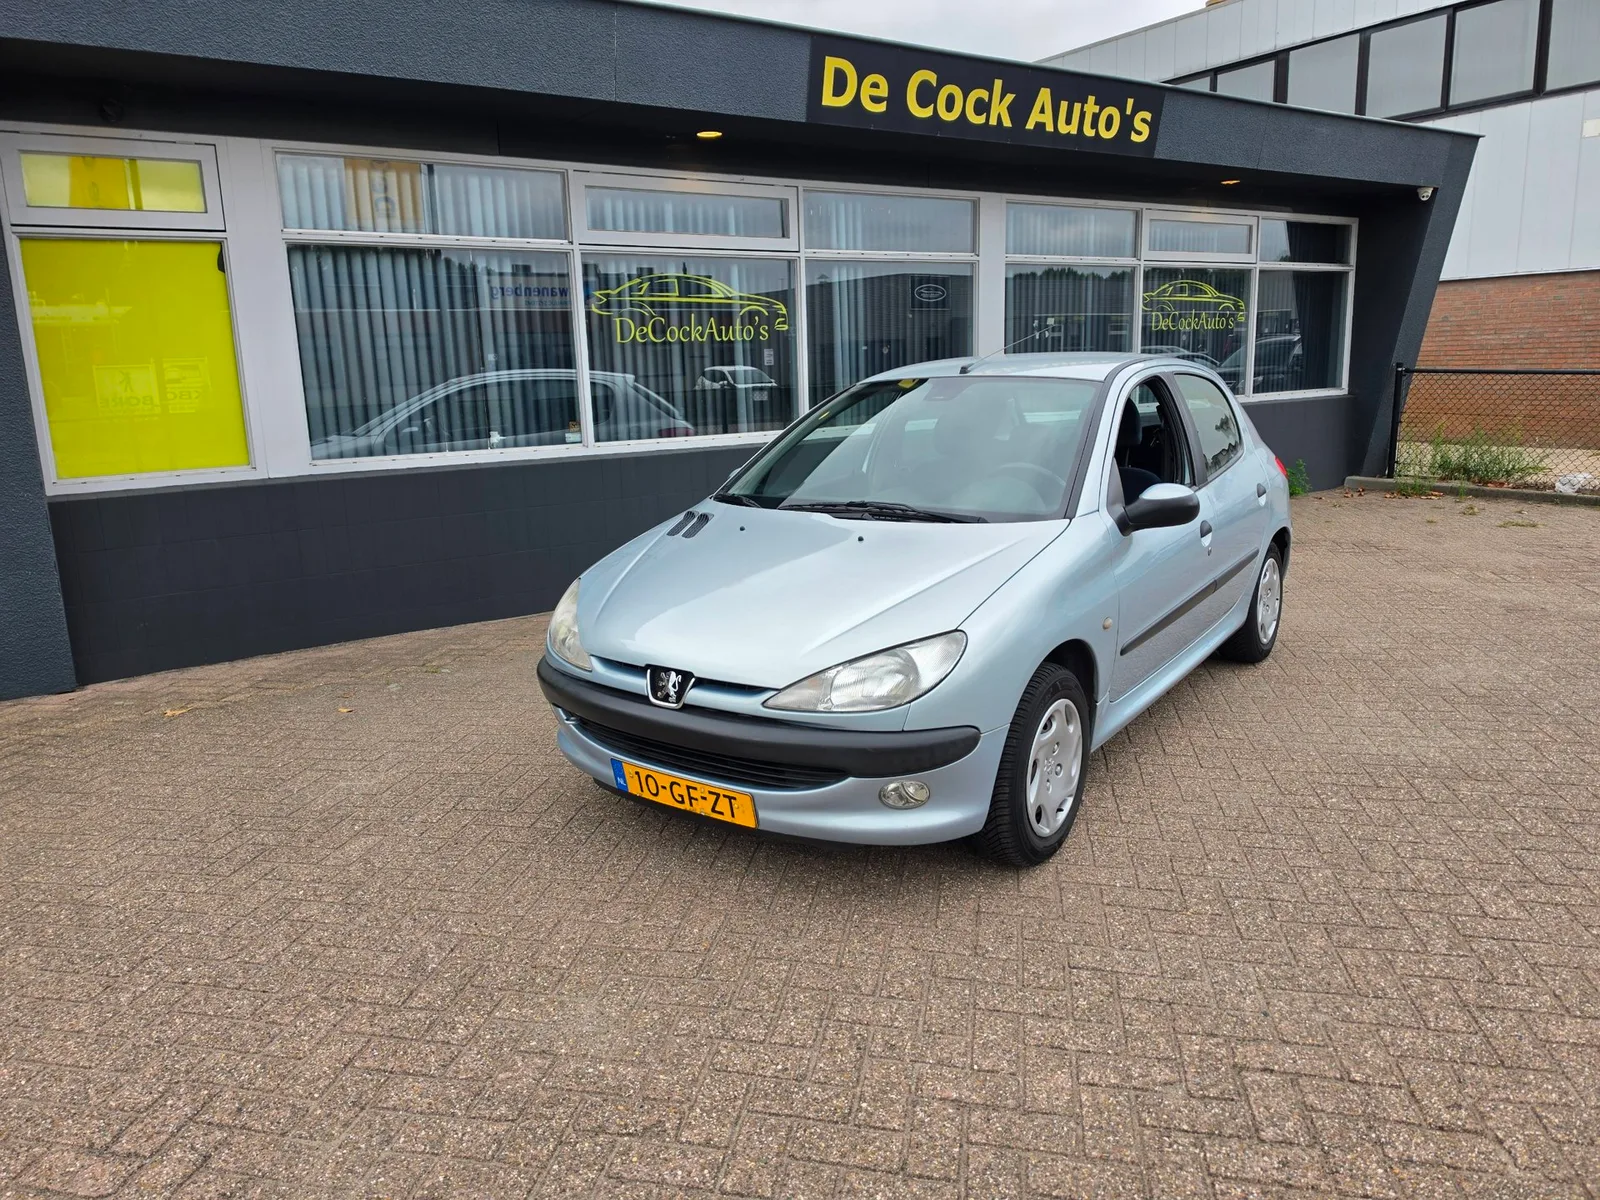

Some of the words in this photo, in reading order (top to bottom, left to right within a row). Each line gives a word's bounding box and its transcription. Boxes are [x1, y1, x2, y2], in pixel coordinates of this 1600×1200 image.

[822, 55, 889, 113] De
[906, 69, 1016, 127] Cock
[1025, 87, 1153, 143] Auto's
[613, 313, 769, 344] DeCockAuto's
[1151, 309, 1235, 331] DeCockAuto's
[617, 776, 627, 787] NL
[634, 770, 738, 819] 10-GF-ZT
